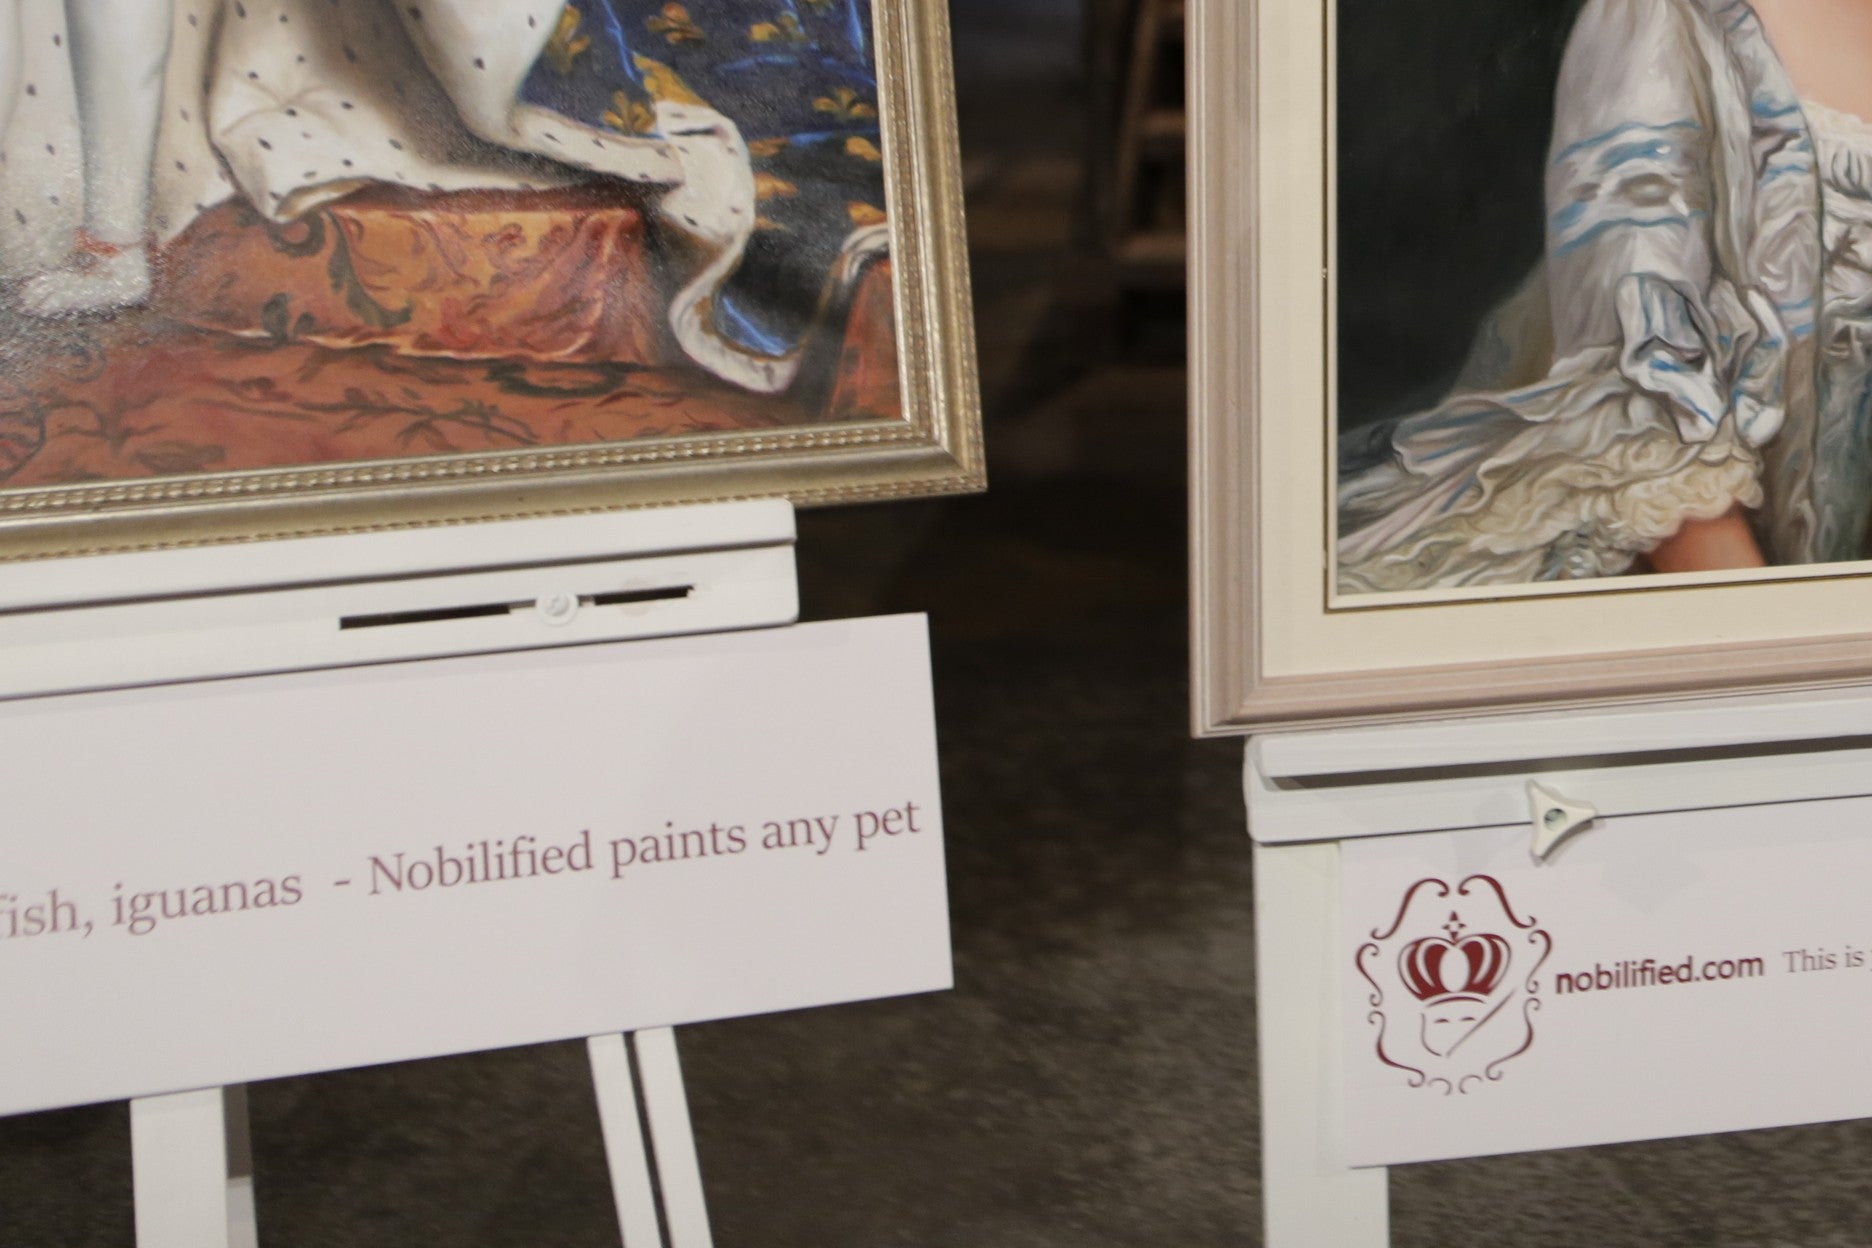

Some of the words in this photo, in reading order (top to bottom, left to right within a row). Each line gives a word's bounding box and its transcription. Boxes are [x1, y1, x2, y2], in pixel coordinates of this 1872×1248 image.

[111, 874, 303, 936] iguanas
[368, 828, 594, 896] Nobilified
[609, 820, 748, 880] paints
[762, 814, 840, 855] any
[854, 800, 921, 851] pet
[1555, 955, 1764, 995] nobilified.com
[1782, 946, 1837, 973] This
[1844, 945, 1864, 969] is
